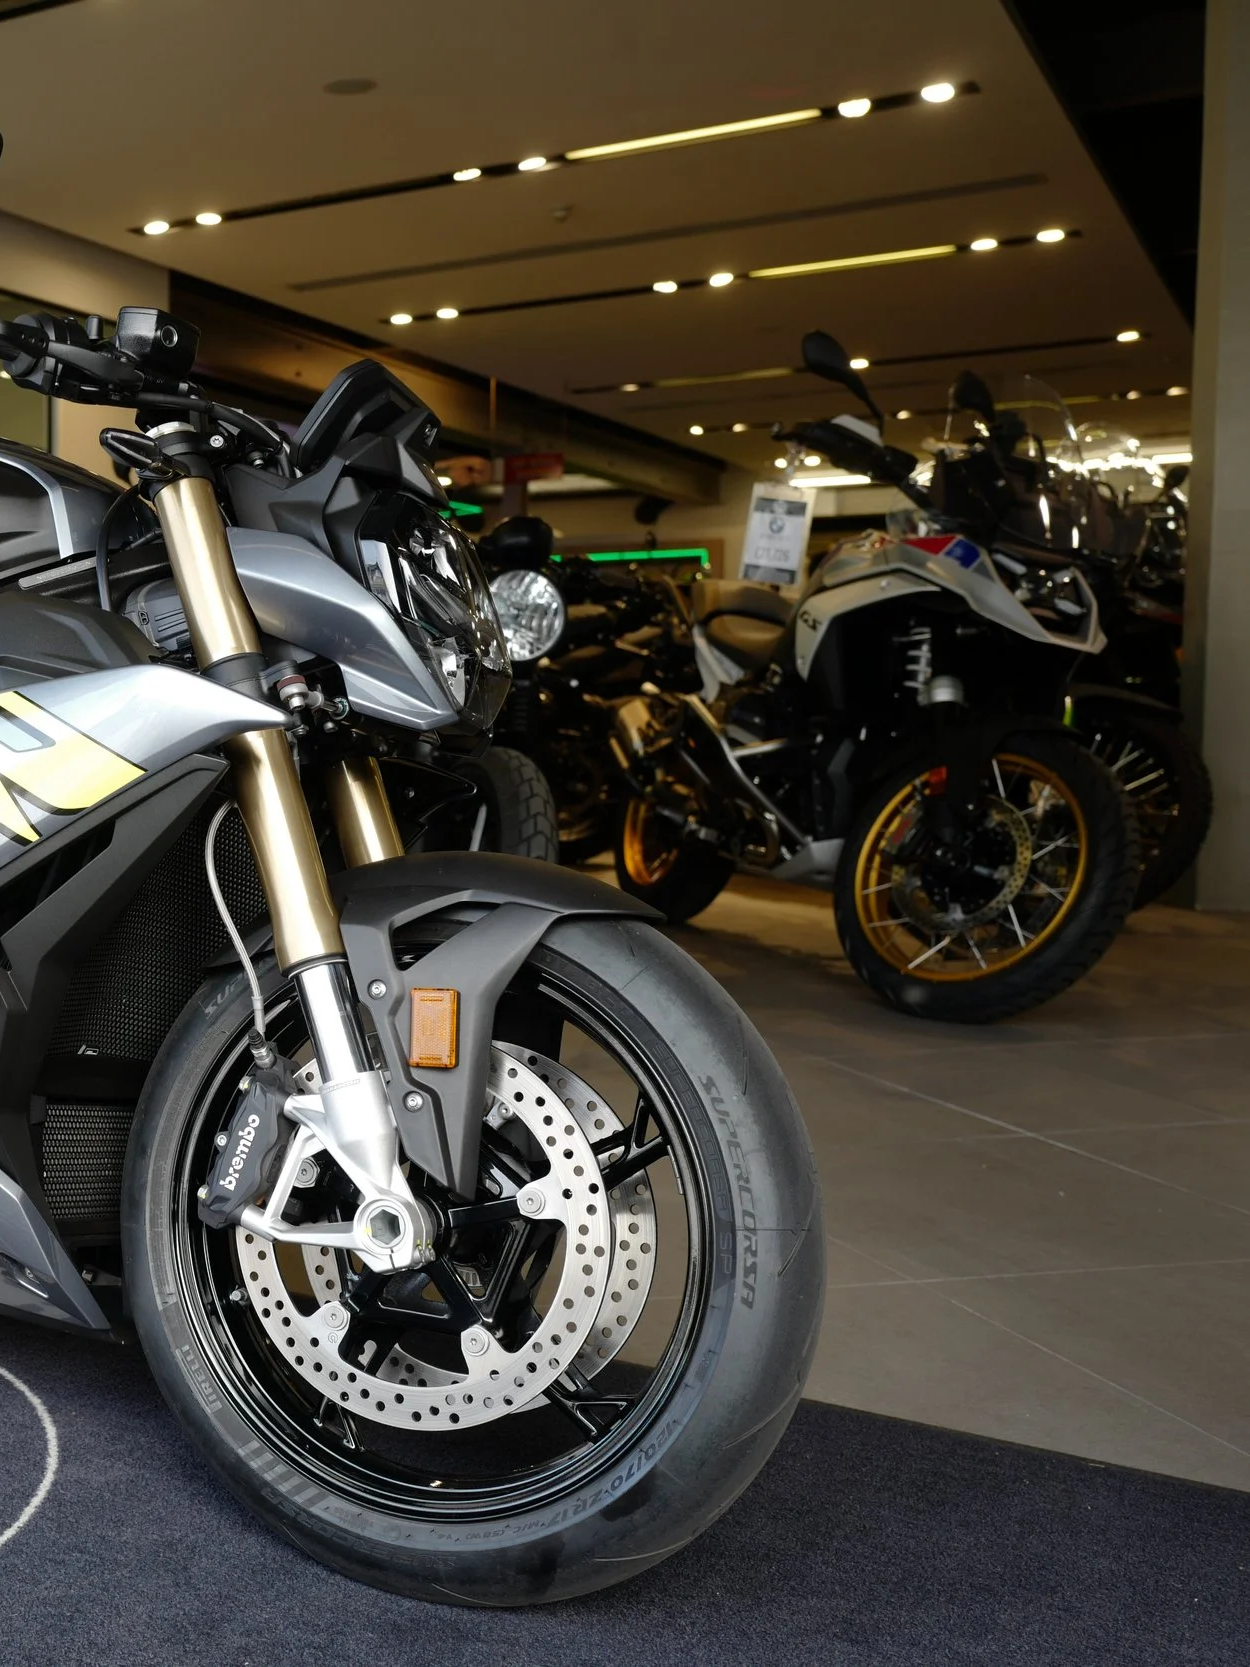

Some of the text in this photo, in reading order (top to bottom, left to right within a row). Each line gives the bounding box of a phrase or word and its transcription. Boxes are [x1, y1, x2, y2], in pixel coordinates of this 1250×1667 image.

[219, 1114, 260, 1192] brembo
[699, 1074, 758, 1310] SUPERCORSA
[718, 1232, 733, 1275] SP
[181, 1344, 223, 1414] PIRELLI
[610, 1419, 677, 1492] 120/70
[550, 1486, 604, 1525] ZR17
